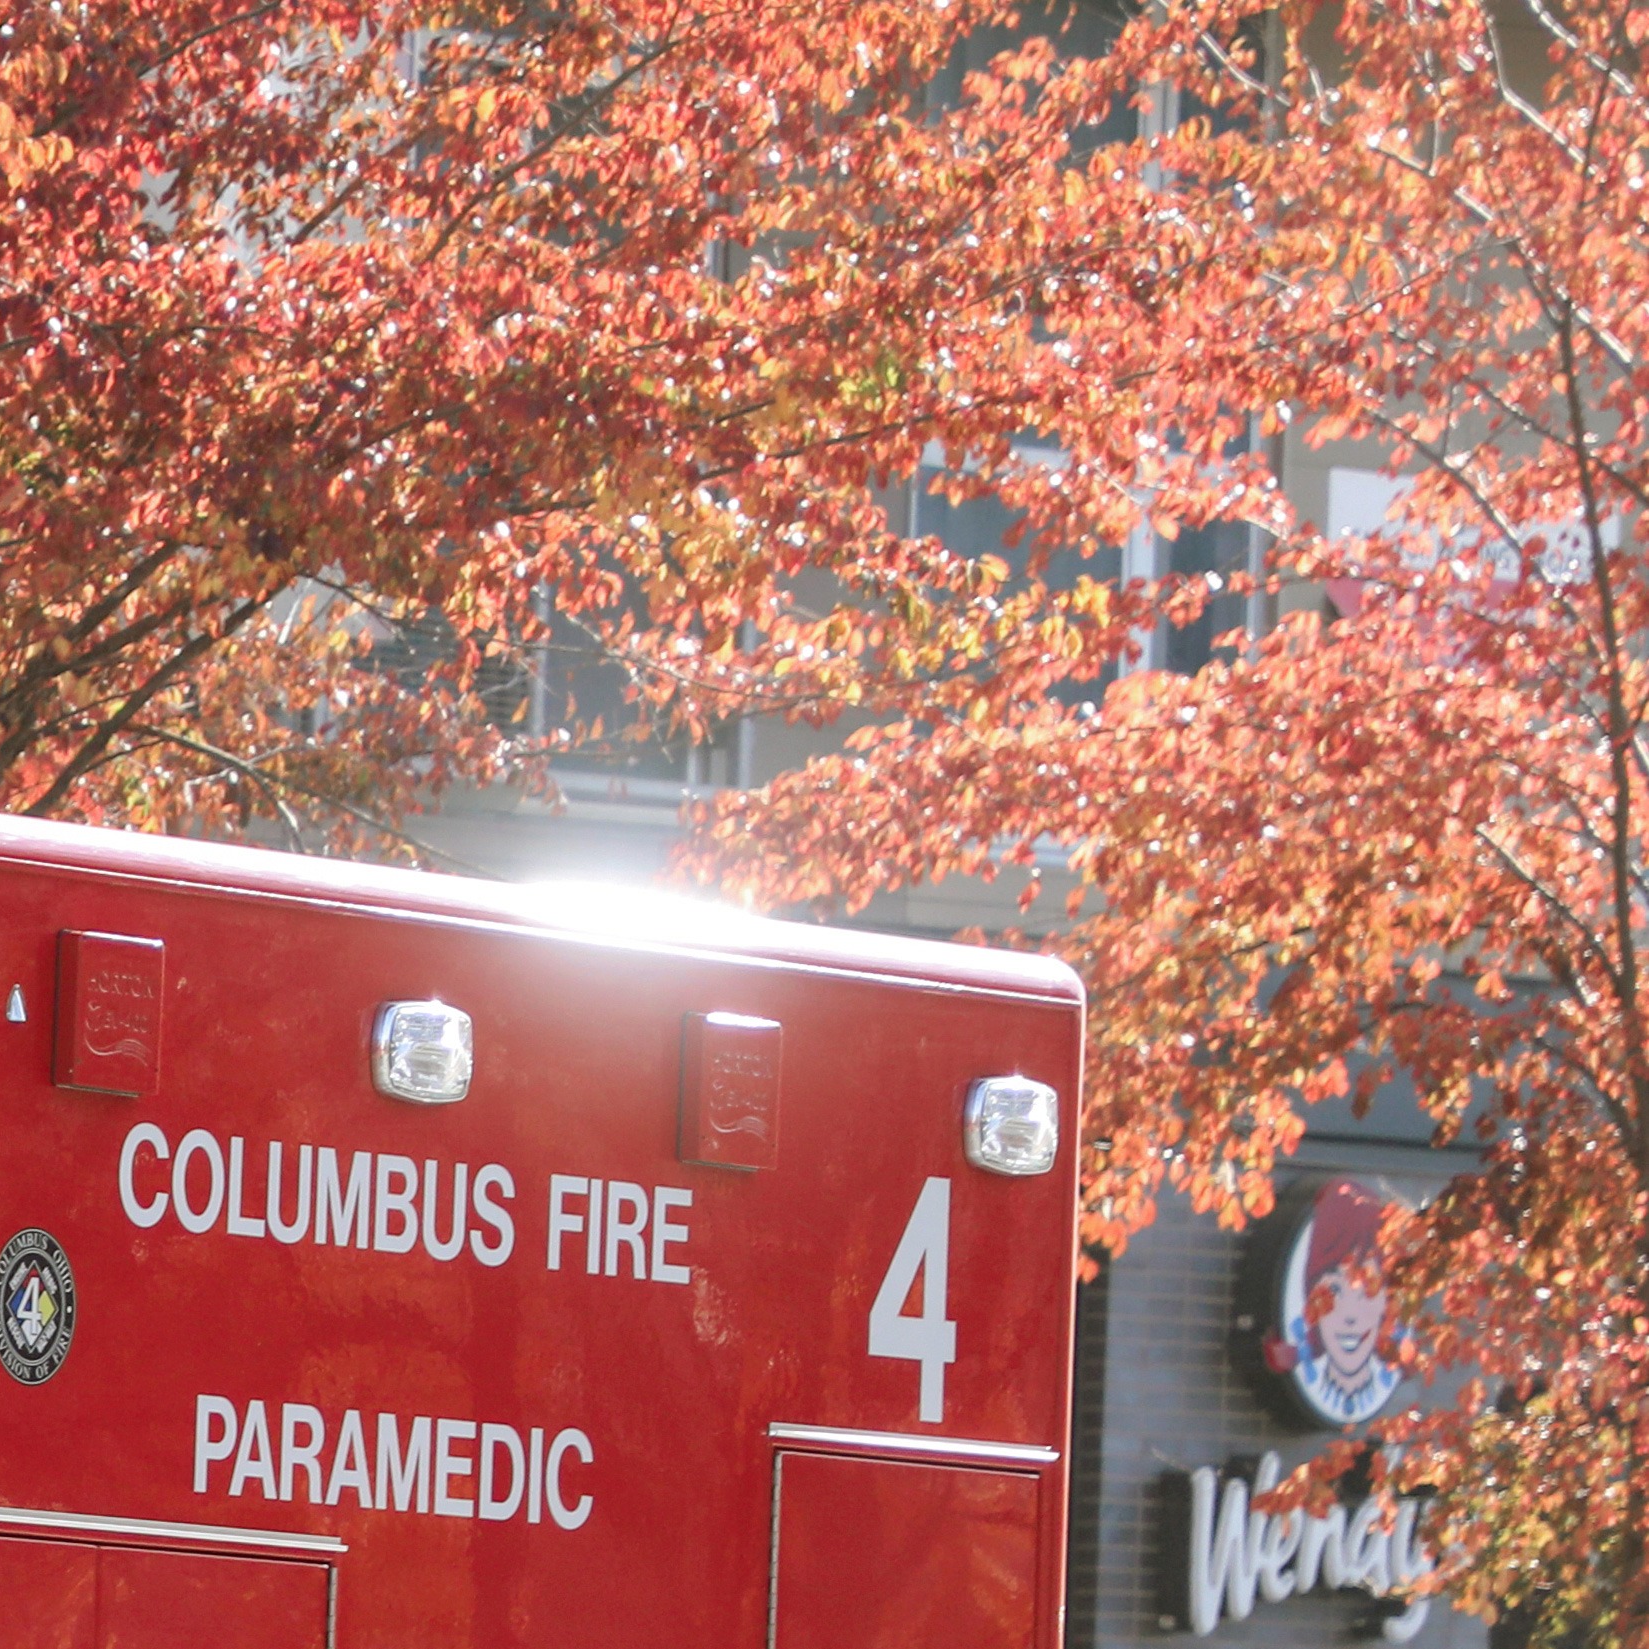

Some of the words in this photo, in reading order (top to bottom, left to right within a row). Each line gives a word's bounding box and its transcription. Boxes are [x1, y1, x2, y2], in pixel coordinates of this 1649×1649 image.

[52, 1250, 73, 1293] OHIO
[118, 1122, 516, 1268] COLUMBUS
[546, 1173, 693, 1284] FIRE
[16, 1277, 42, 1336] 4
[35, 1364, 51, 1379] OF
[52, 1327, 71, 1364] FIRE
[868, 1176, 956, 1423] 4
[193, 1393, 594, 1530] PARAMEDIC
[1190, 1450, 1477, 1643] Wendy
